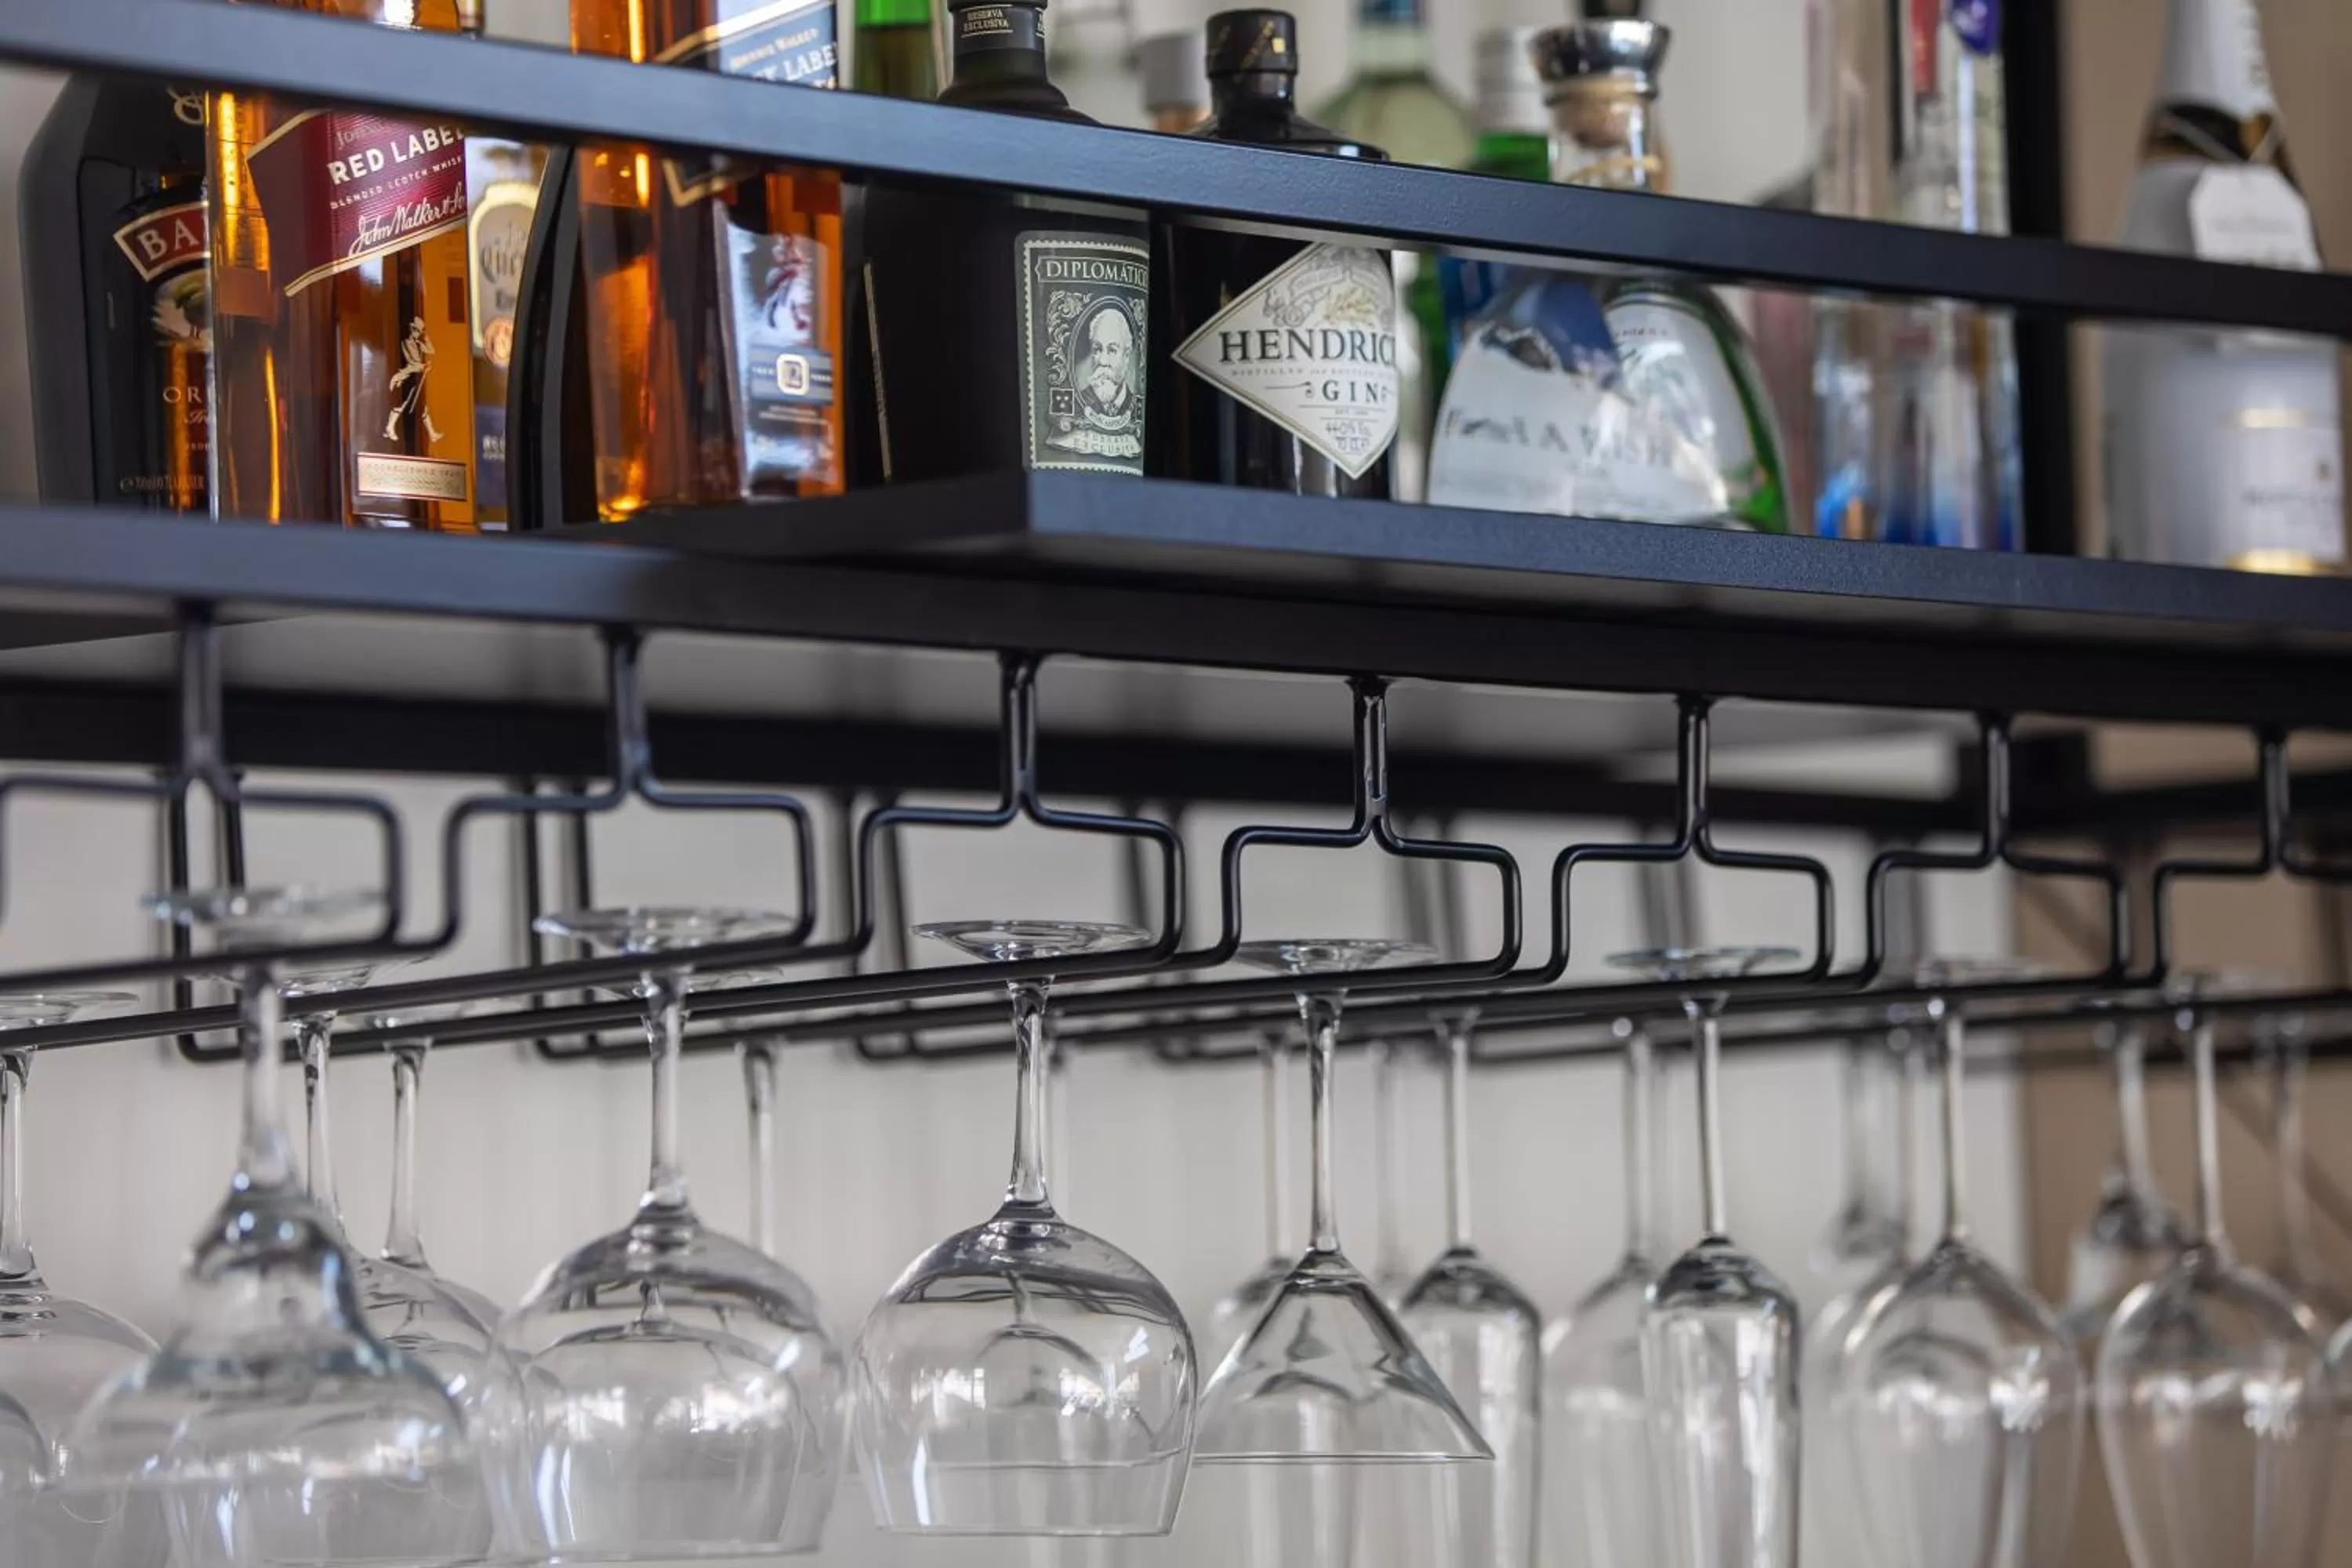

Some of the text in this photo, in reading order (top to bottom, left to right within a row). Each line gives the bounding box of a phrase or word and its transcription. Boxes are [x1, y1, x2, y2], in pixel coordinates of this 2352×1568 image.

[963, 18, 1010, 32] EXCLUSIVA
[782, 42, 837, 82] LABE
[326, 147, 385, 186] RED
[328, 185, 384, 210] BLENDED
[388, 166, 428, 190] SCOTCH
[136, 216, 207, 253] BA
[1321, 379, 1379, 404] GIN
